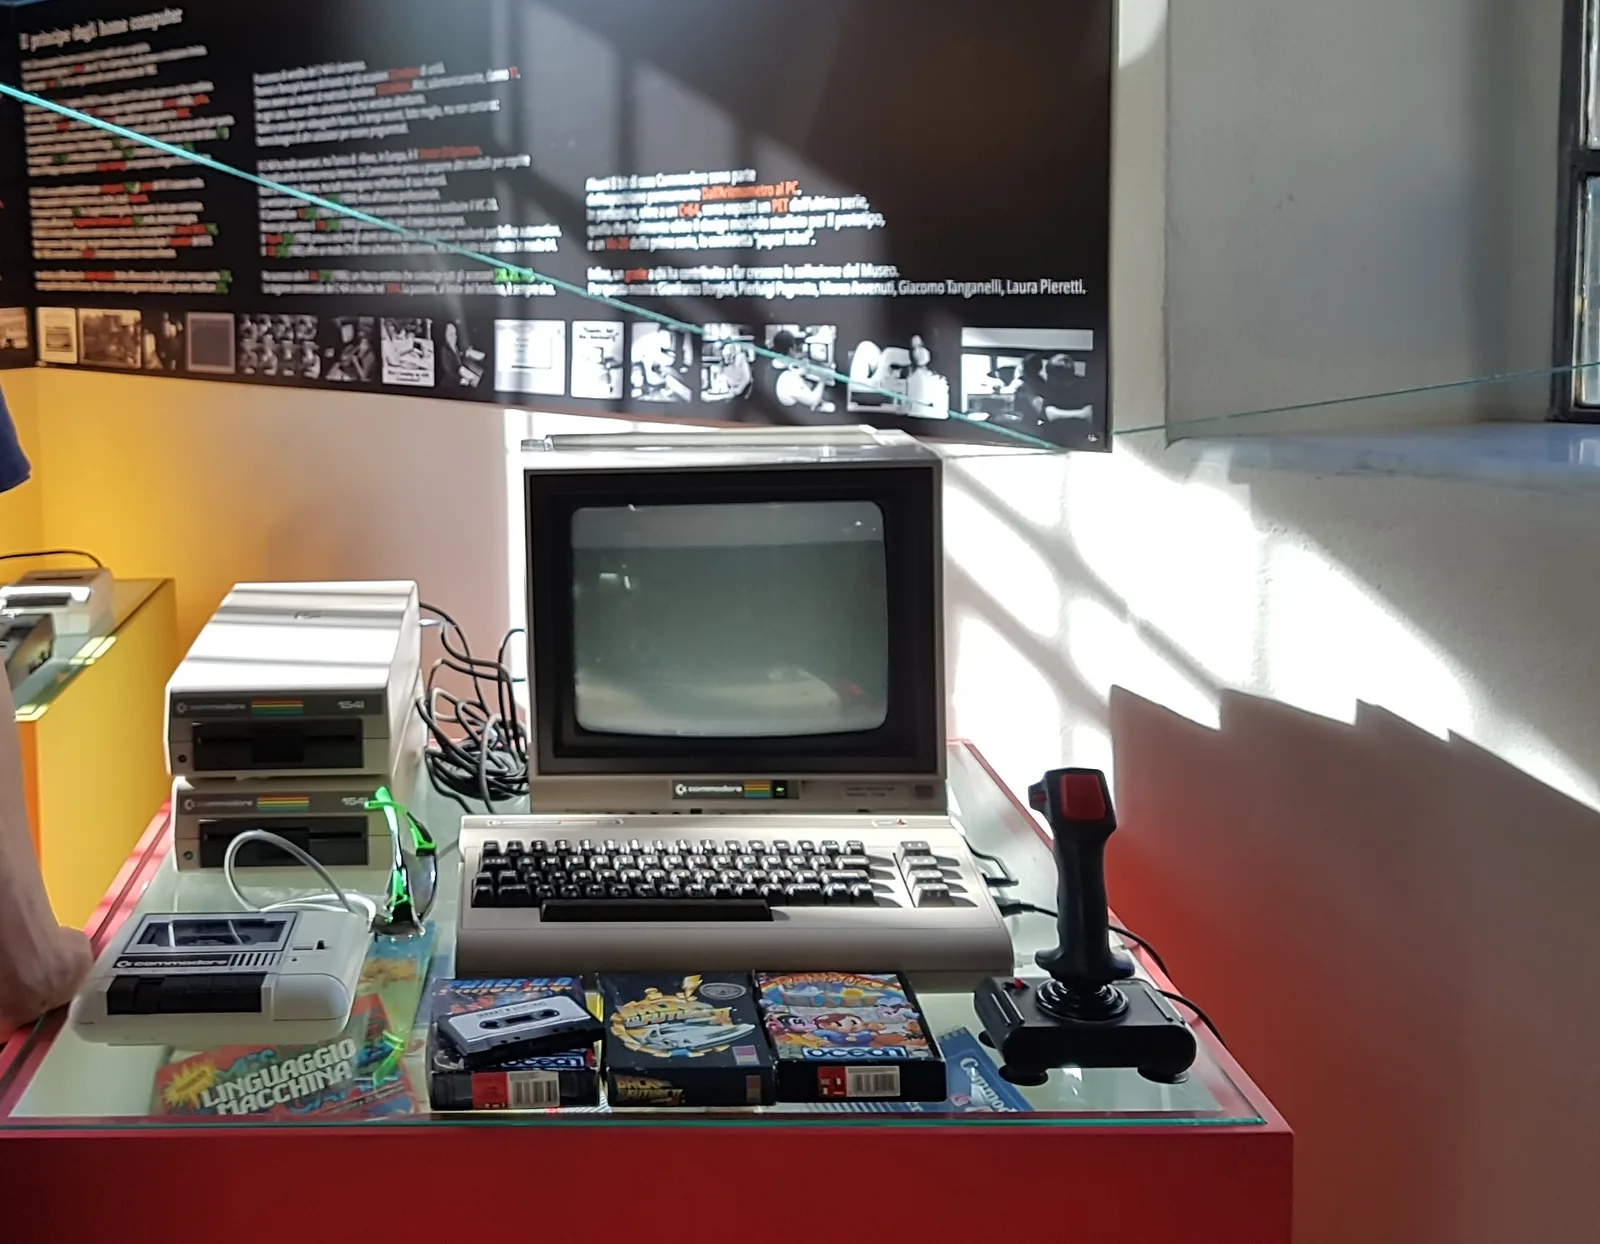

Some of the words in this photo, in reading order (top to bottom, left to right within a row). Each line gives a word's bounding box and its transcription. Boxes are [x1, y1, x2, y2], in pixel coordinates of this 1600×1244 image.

[860, 262, 900, 279] Museo.
[899, 279, 945, 296] Giacomo
[946, 279, 1005, 298] Tanganelli,
[1006, 279, 1038, 295] Laura
[1039, 278, 1087, 295] Pieretti.
[337, 700, 365, 709] 1541
[688, 785, 743, 793] commodore
[134, 959, 228, 969] commodore
[805, 1046, 908, 1058] ocean
[201, 1038, 358, 1109] LINGUAGGIO
[216, 1060, 352, 1115] MACCHINA
